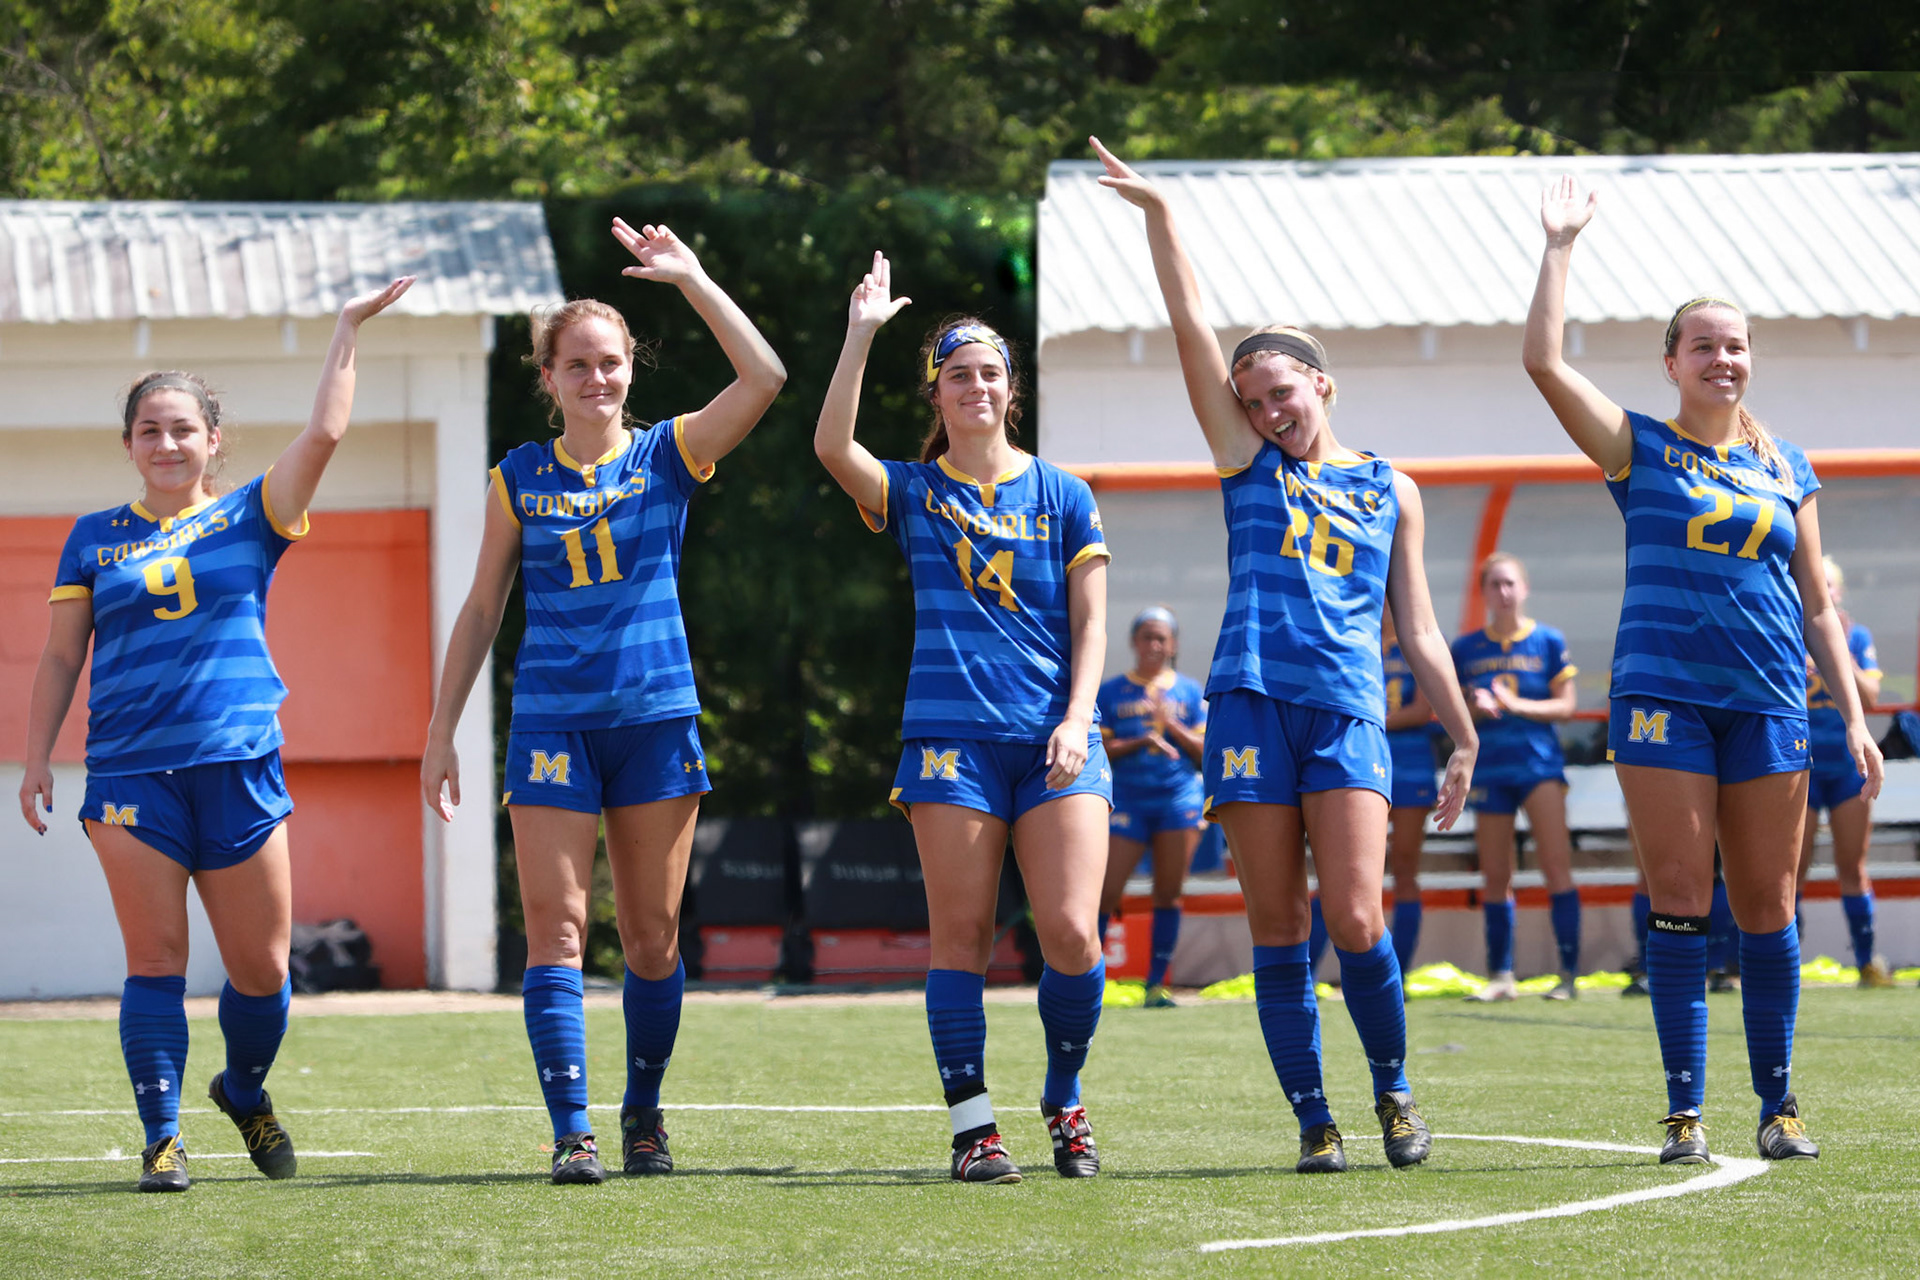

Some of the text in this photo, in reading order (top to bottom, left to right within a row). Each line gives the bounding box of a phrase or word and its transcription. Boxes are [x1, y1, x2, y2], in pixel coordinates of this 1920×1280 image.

[1280, 507, 1355, 577] 26
[1686, 486, 1776, 560] 27
[560, 517, 624, 588] 11
[953, 536, 1020, 612] 14
[142, 556, 199, 620] 9
[1628, 708, 1671, 745] M
[528, 749, 571, 786] M
[920, 746, 961, 781] M
[1222, 745, 1260, 780] M
[101, 801, 139, 826] M
